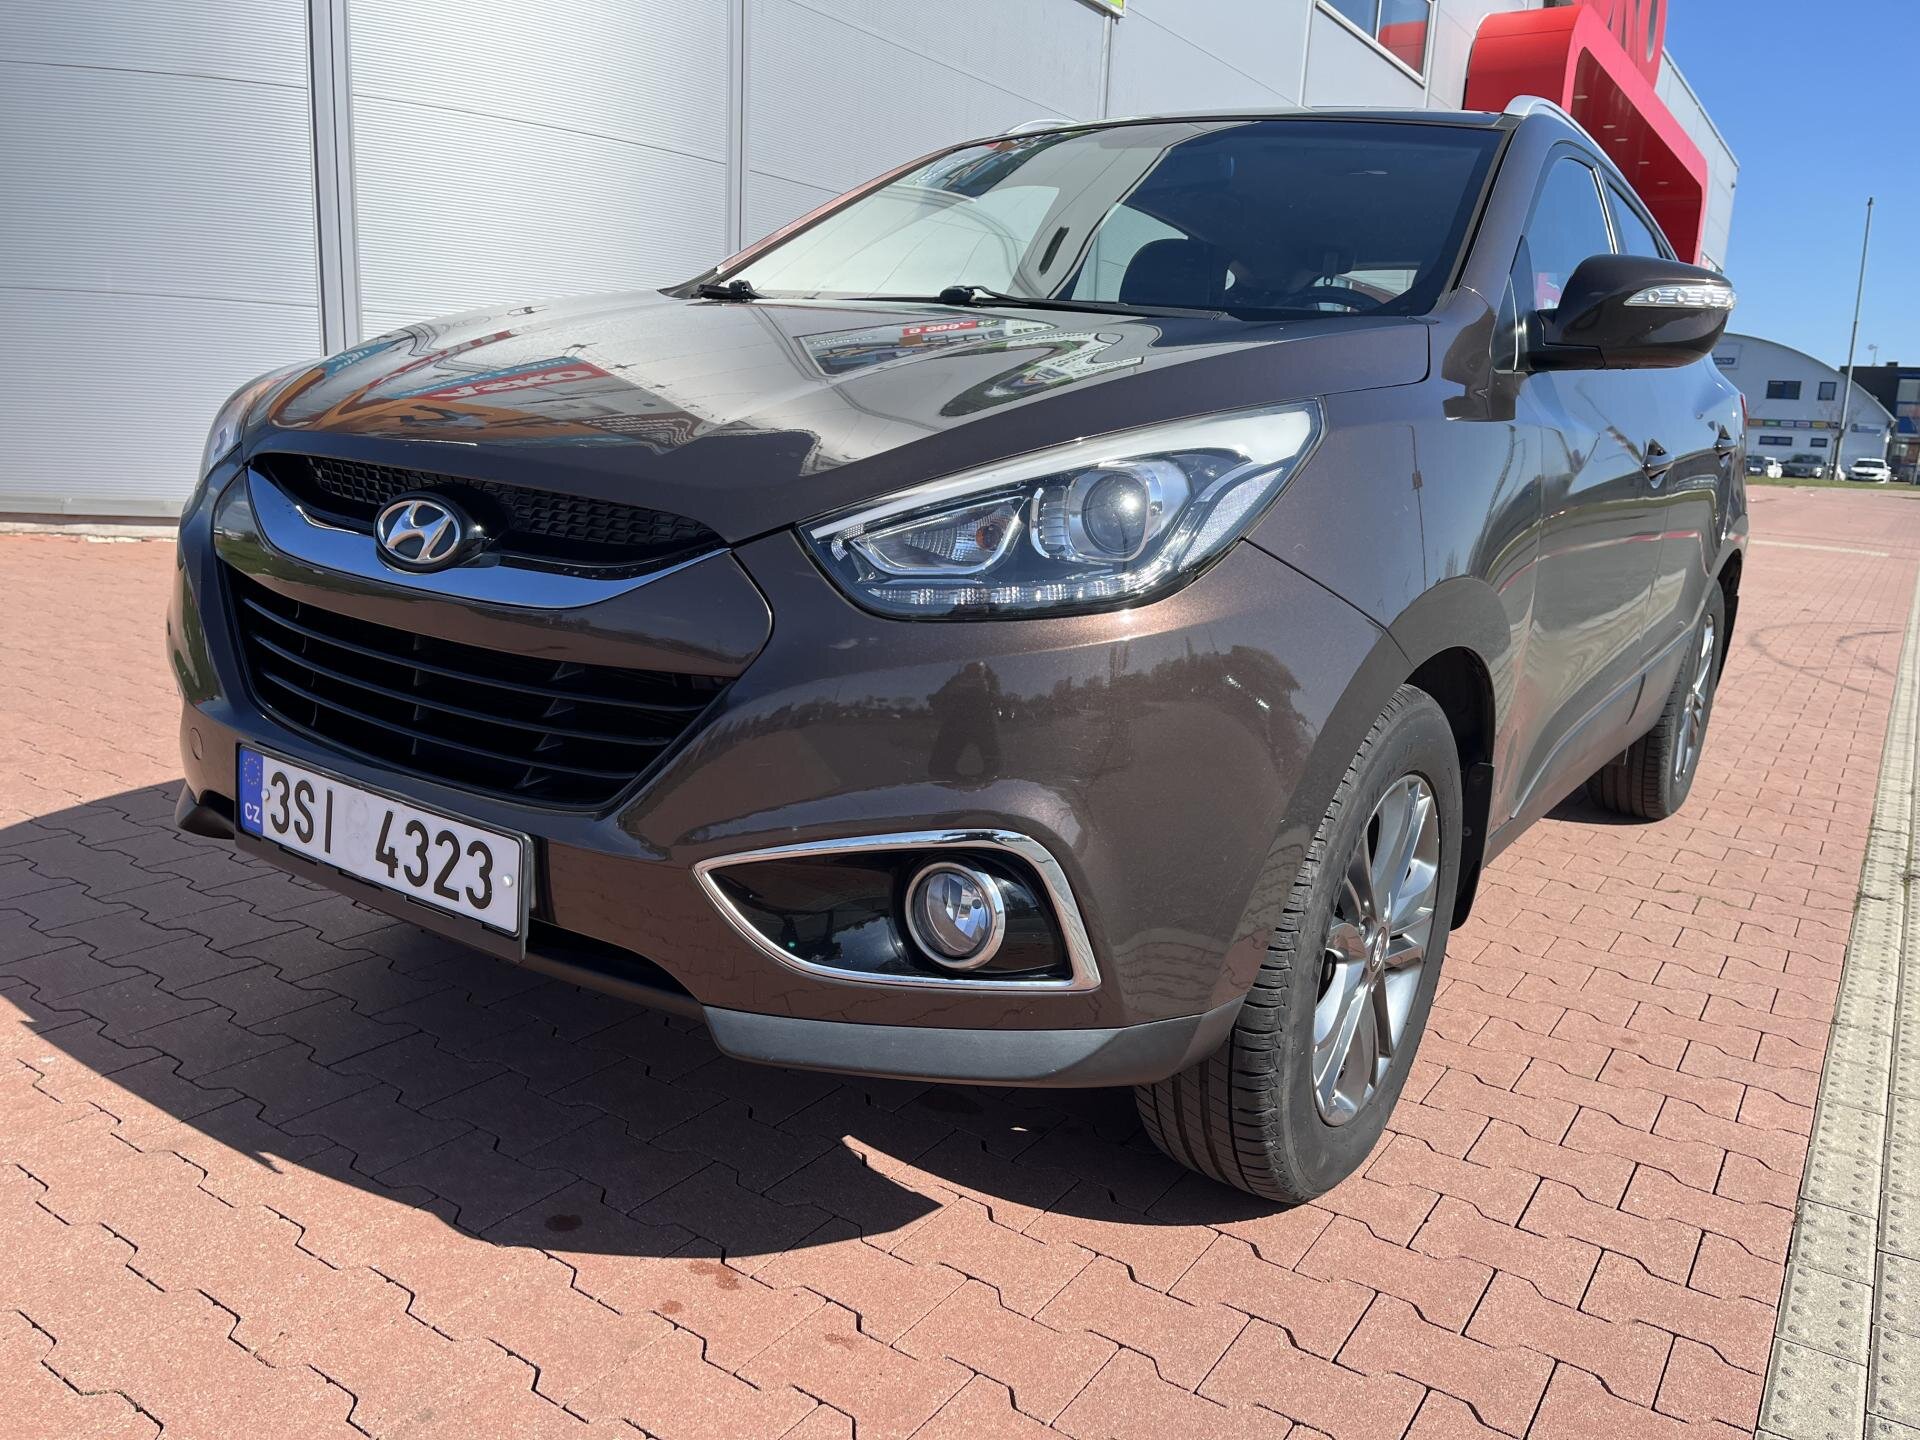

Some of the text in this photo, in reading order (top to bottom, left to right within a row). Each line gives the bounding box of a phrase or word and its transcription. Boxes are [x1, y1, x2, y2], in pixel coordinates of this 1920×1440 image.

[244, 802, 261, 824] CZ
[270, 771, 494, 910] 3SI 4323
